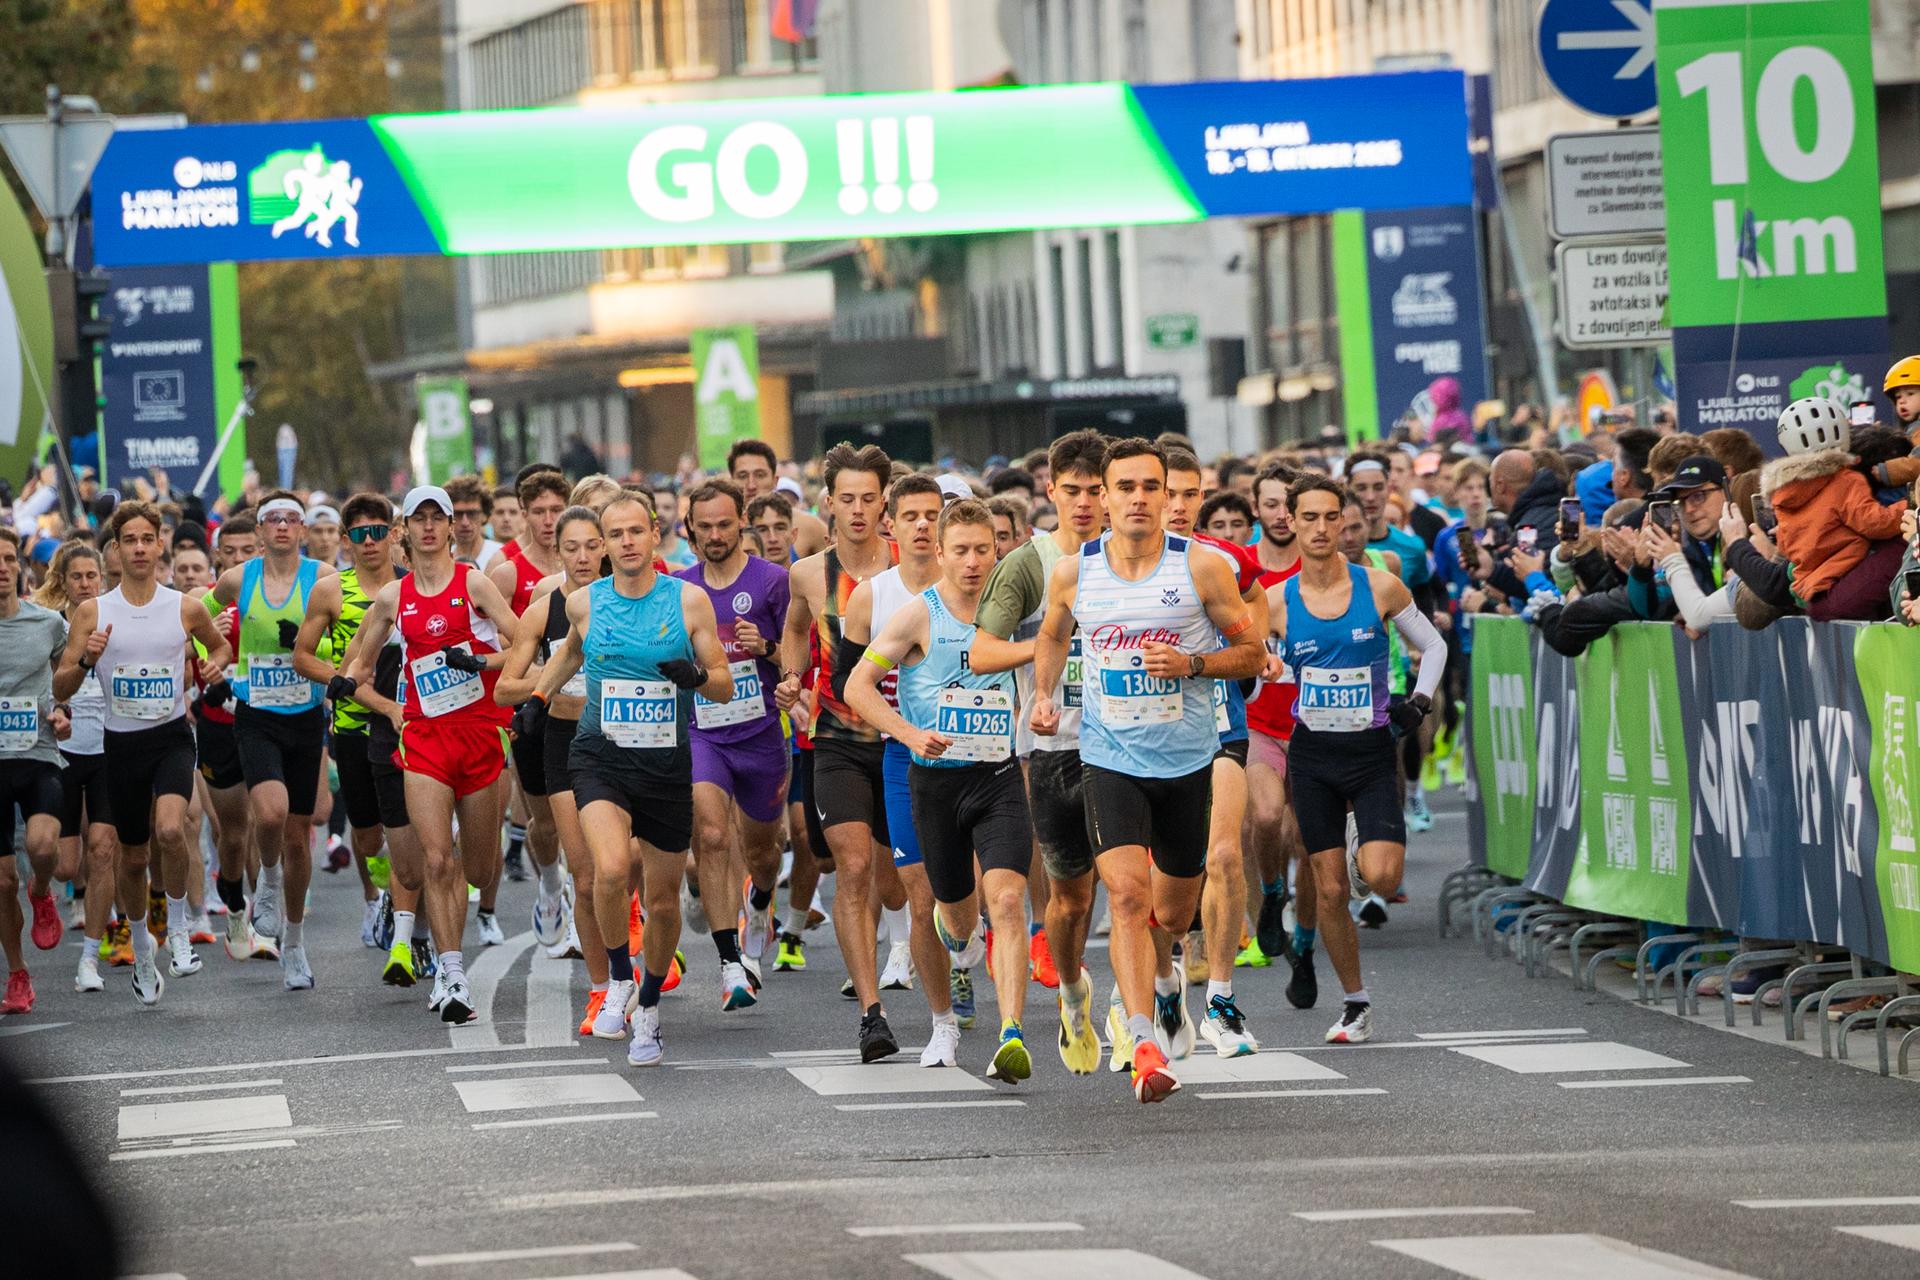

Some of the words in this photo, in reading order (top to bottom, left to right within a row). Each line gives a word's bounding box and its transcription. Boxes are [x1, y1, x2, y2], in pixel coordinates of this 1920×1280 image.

[1675, 45, 1855, 186] 10
[627, 121, 809, 222] GO
[836, 116, 939, 215] !!!
[1713, 199, 1858, 281] km
[1587, 252, 1617, 266] Levo
[1592, 276, 1608, 289] za
[1613, 272, 1651, 287] vozila
[1590, 294, 1651, 312] avtotaksi
[1578, 323, 1585, 335] z
[698, 339, 757, 402] A
[1698, 395, 1781, 410] LJUBLJANSKI
[426, 391, 465, 437] B
[1700, 406, 1782, 424] MARATON
[124, 437, 200, 460] TIMING
[1091, 624, 1183, 651] Dublin
[257, 670, 265, 686] A
[423, 678, 434, 695] A
[119, 681, 129, 698] B
[132, 681, 172, 699] 13400
[1308, 687, 1318, 706] A
[1321, 686, 1368, 707] 13817
[611, 701, 622, 721] A
[626, 701, 673, 722] 16564
[946, 711, 958, 732] A
[963, 712, 1008, 735] 19265
